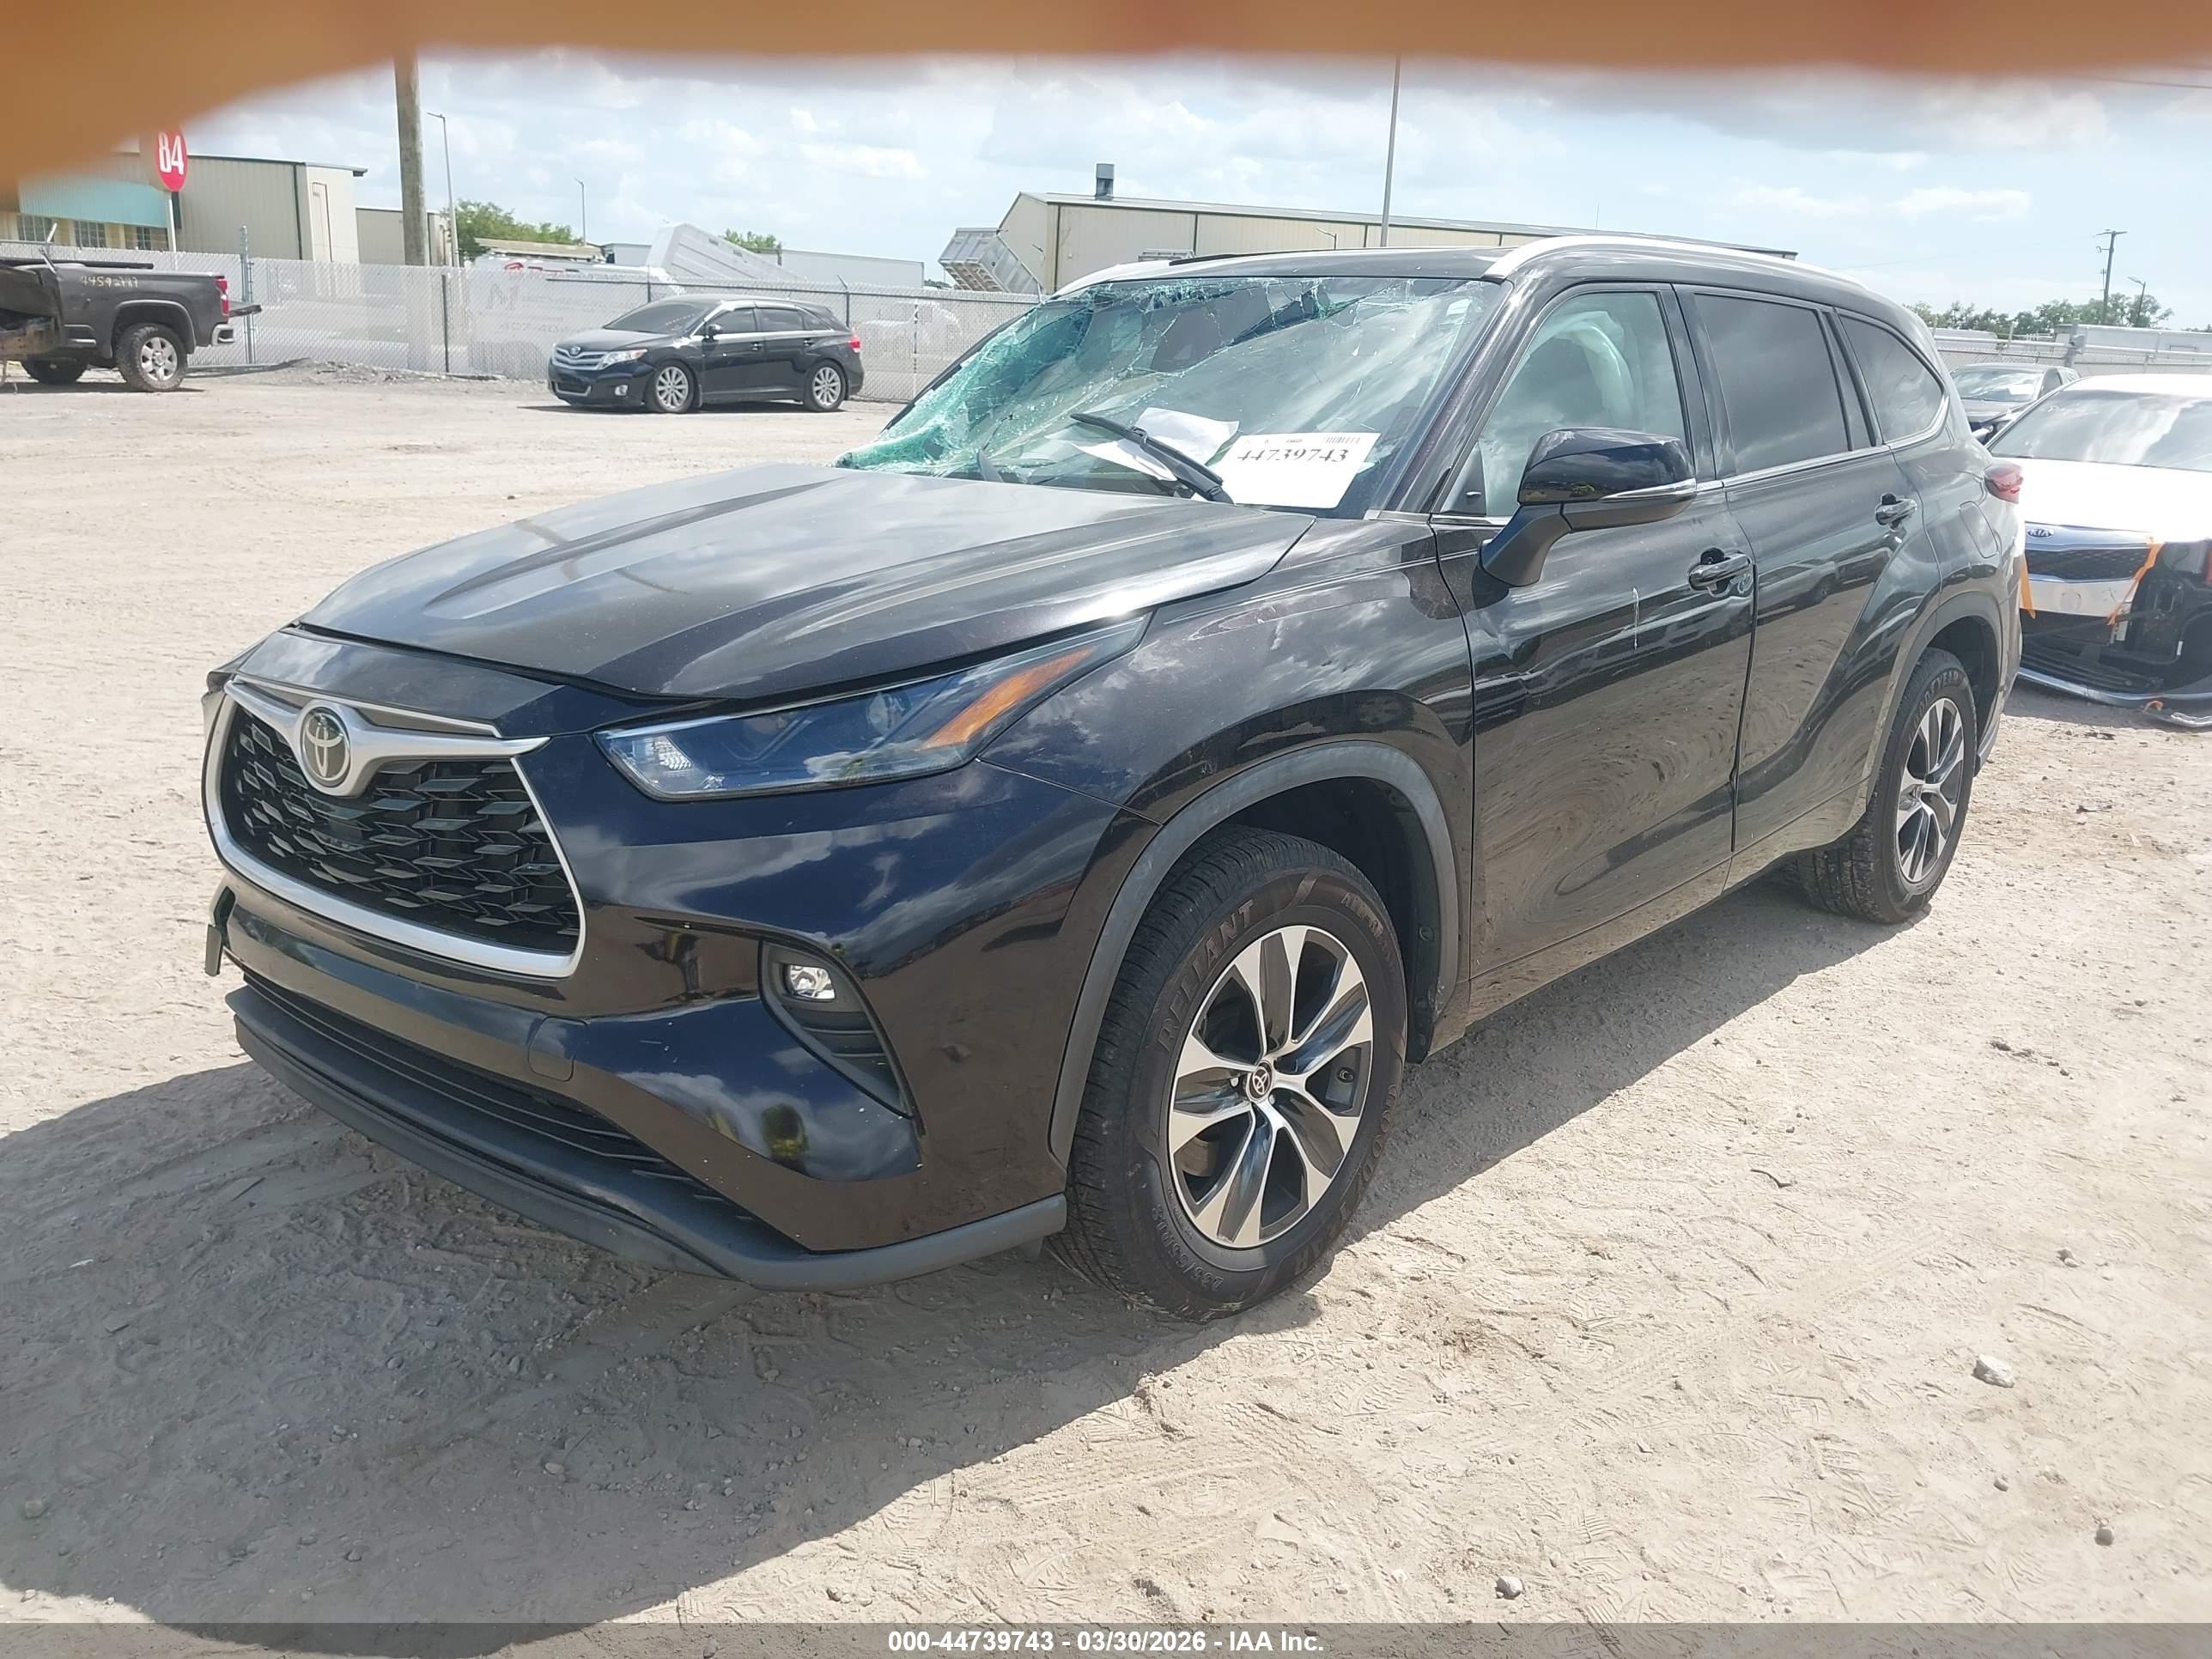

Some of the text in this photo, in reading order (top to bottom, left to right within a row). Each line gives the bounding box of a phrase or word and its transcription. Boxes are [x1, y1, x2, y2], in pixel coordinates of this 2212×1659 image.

[158, 133, 184, 174] 84
[1237, 448, 1348, 462] 44739743
[1154, 896, 1255, 1052] RELIANT
